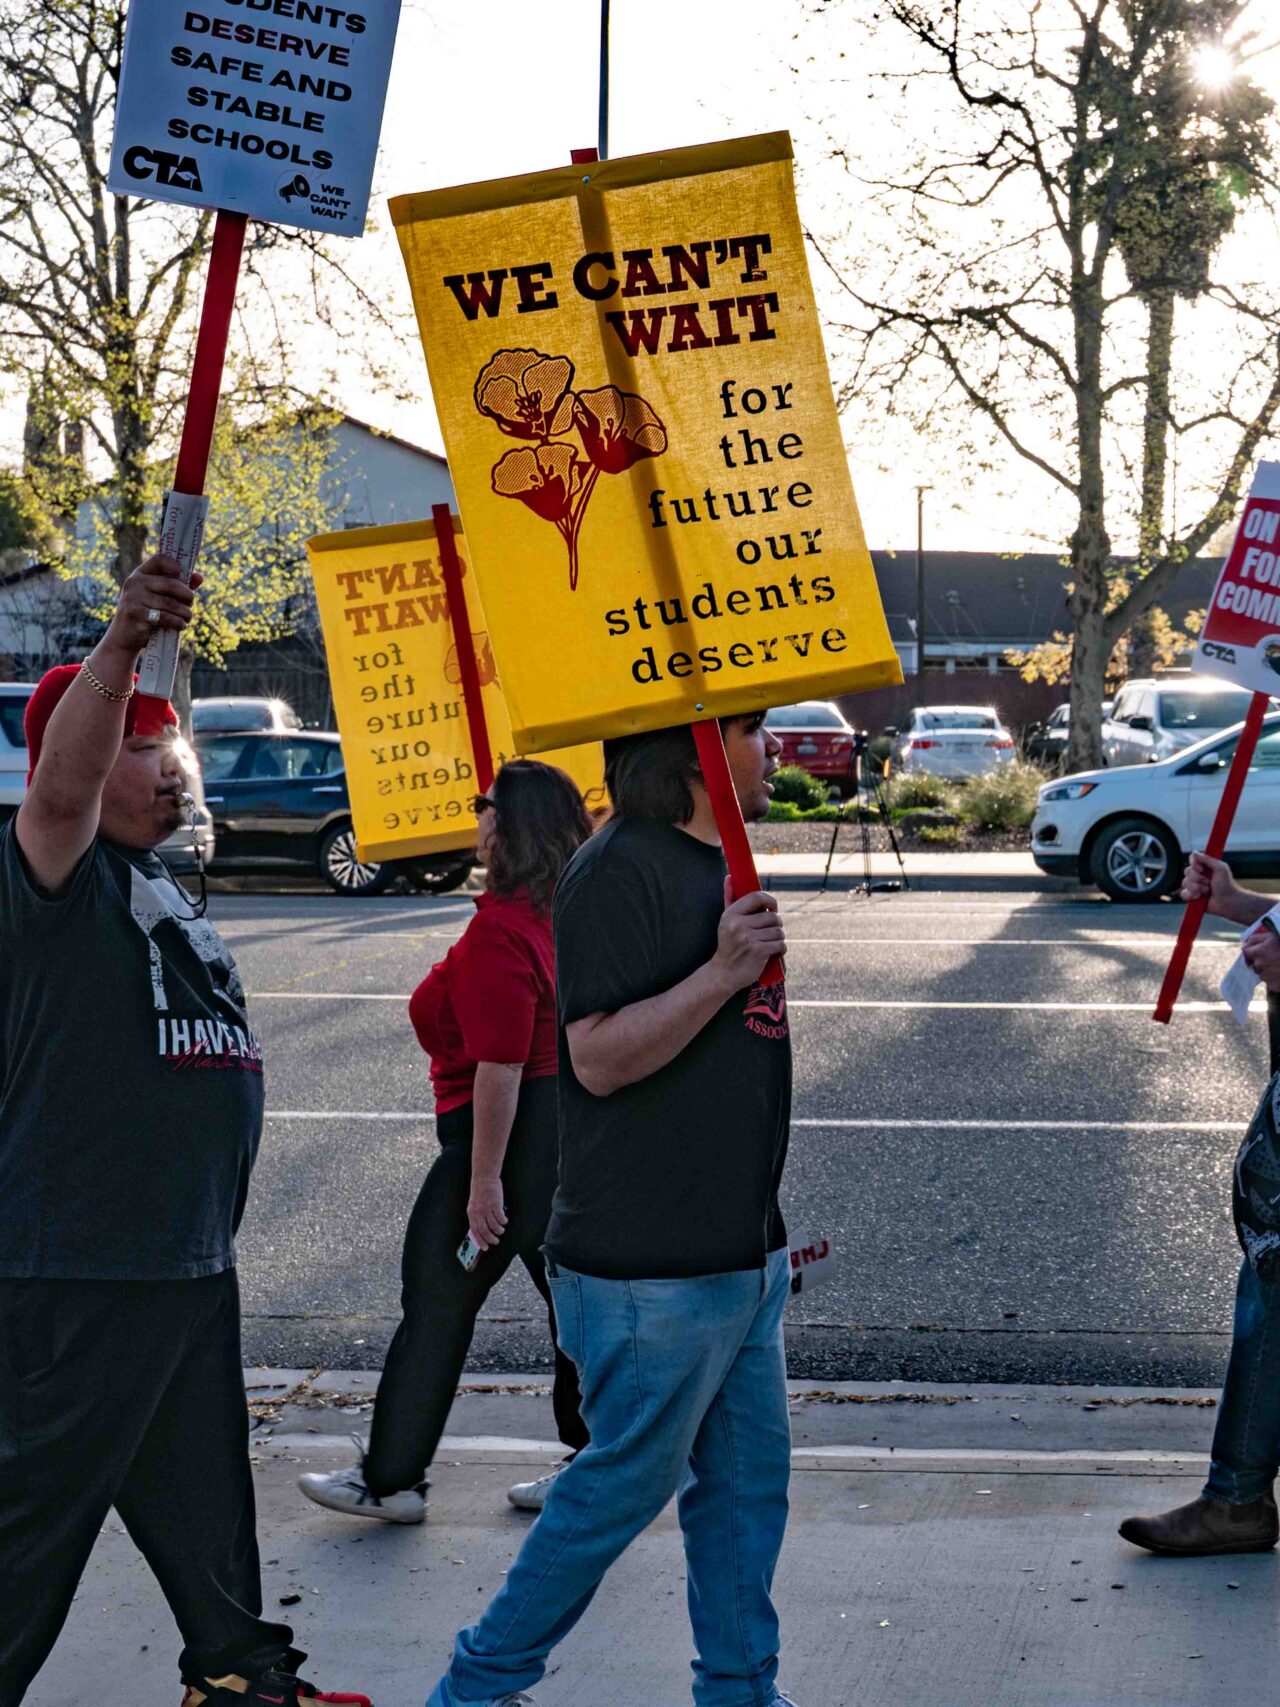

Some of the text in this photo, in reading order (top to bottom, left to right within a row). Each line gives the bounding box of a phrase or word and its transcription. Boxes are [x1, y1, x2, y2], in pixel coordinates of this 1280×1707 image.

[184, 11, 350, 67] DESERVE
[224, 0, 366, 34] DENTS
[170, 46, 352, 102] SAFE AND
[187, 86, 325, 133] STABLE
[168, 119, 333, 170] SCHOOLS
[123, 145, 203, 192] CTA
[321, 183, 344, 196] WE
[310, 205, 347, 220] WAIT
[444, 234, 772, 321] WE CAN'T
[606, 292, 779, 357] WAIT
[720, 380, 793, 418] for
[719, 429, 803, 468] the
[648, 480, 813, 528] future
[1243, 508, 1280, 544] ON
[737, 528, 823, 565] our
[605, 572, 835, 636] students
[631, 628, 848, 684] deserve
[1201, 642, 1236, 665] CTA
[158, 1018, 167, 1055] I
